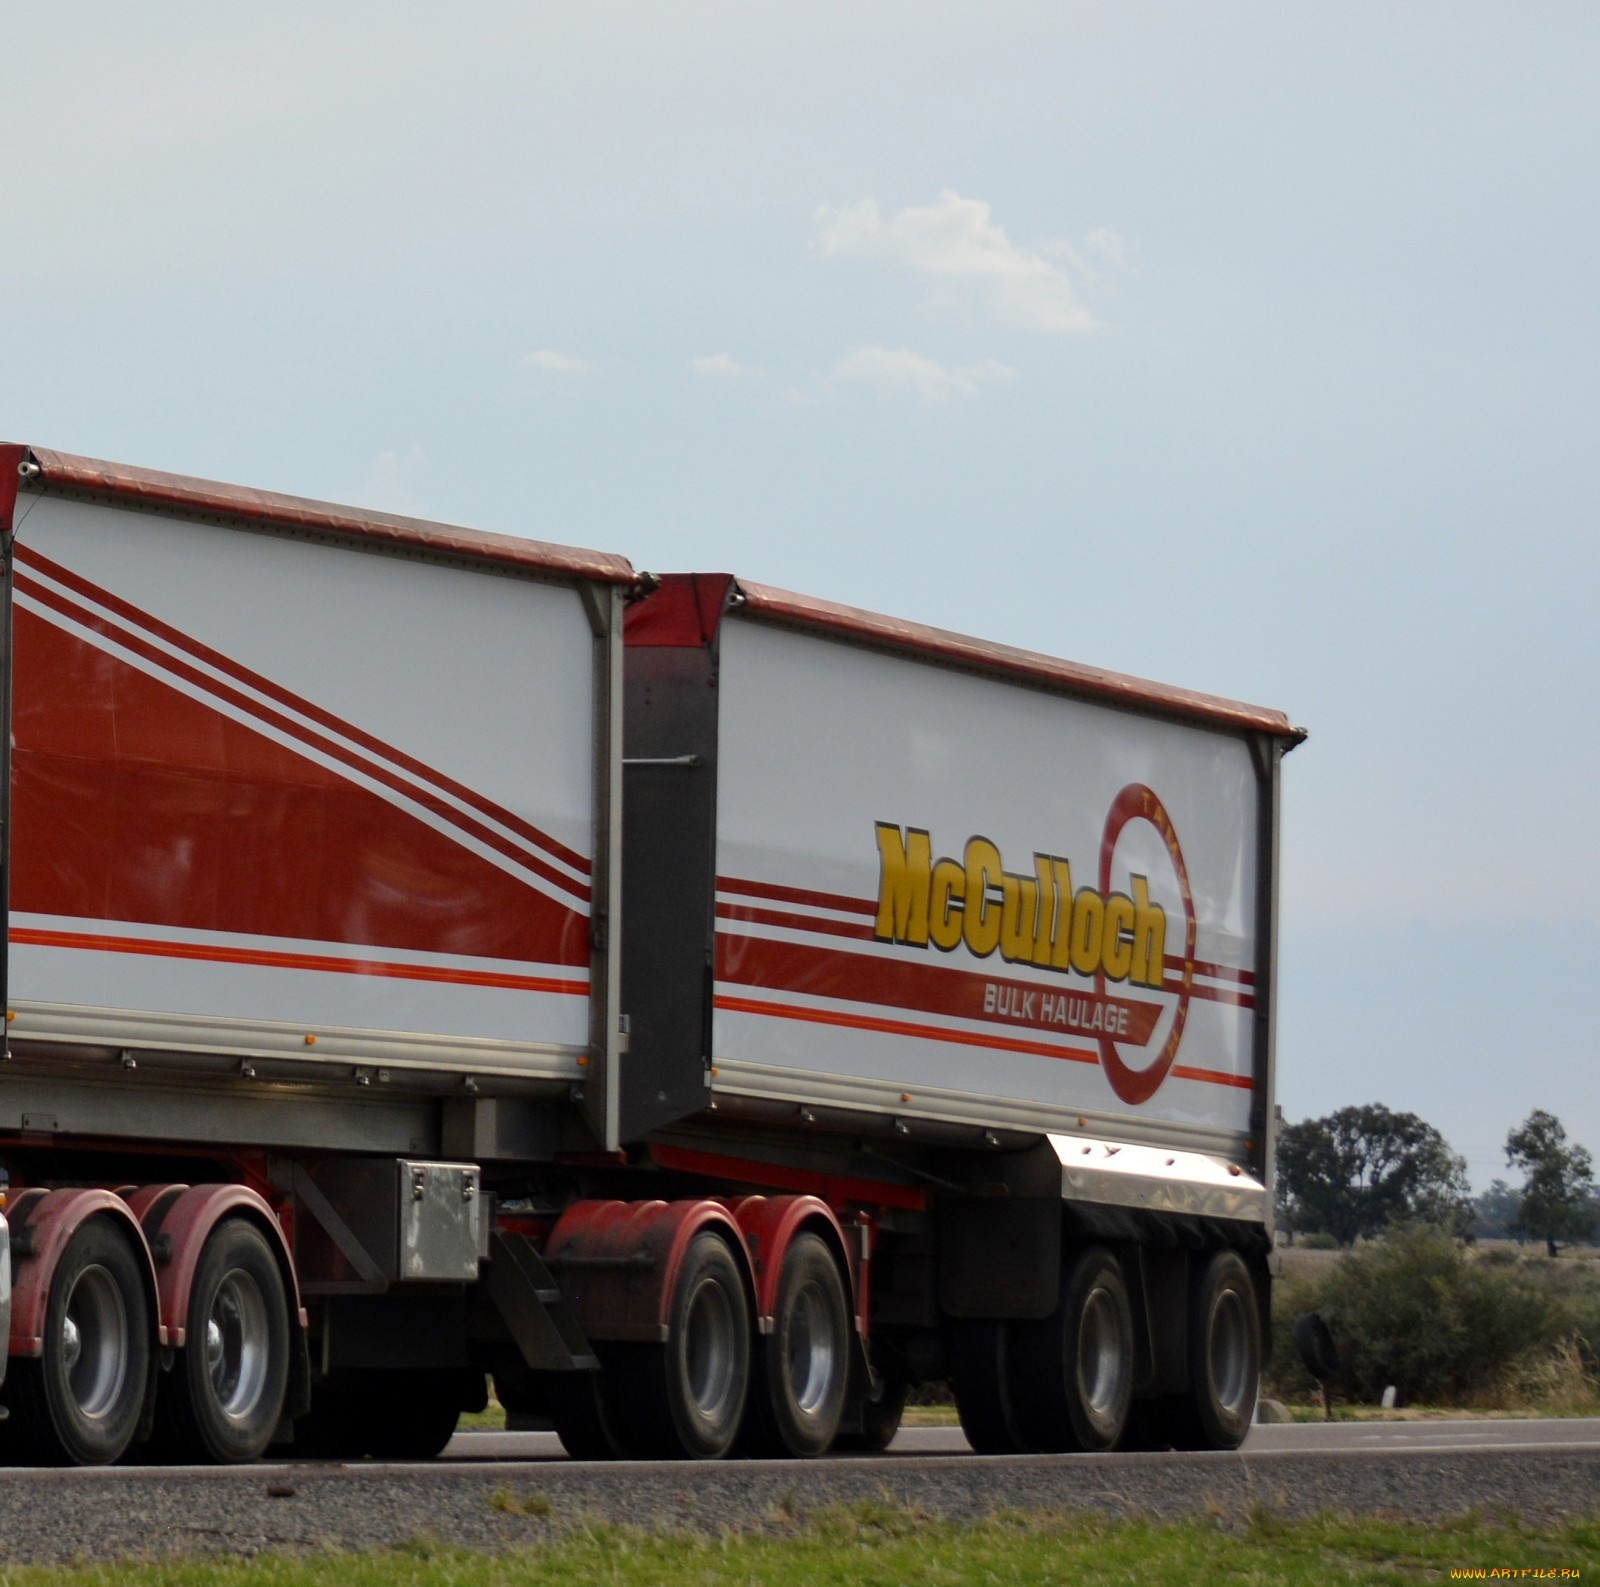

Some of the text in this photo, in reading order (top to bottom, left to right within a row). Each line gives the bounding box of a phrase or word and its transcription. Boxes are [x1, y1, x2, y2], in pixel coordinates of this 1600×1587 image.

[874, 820, 1166, 991] McCulloch
[983, 983, 1129, 1035] BULK HAULAGE
